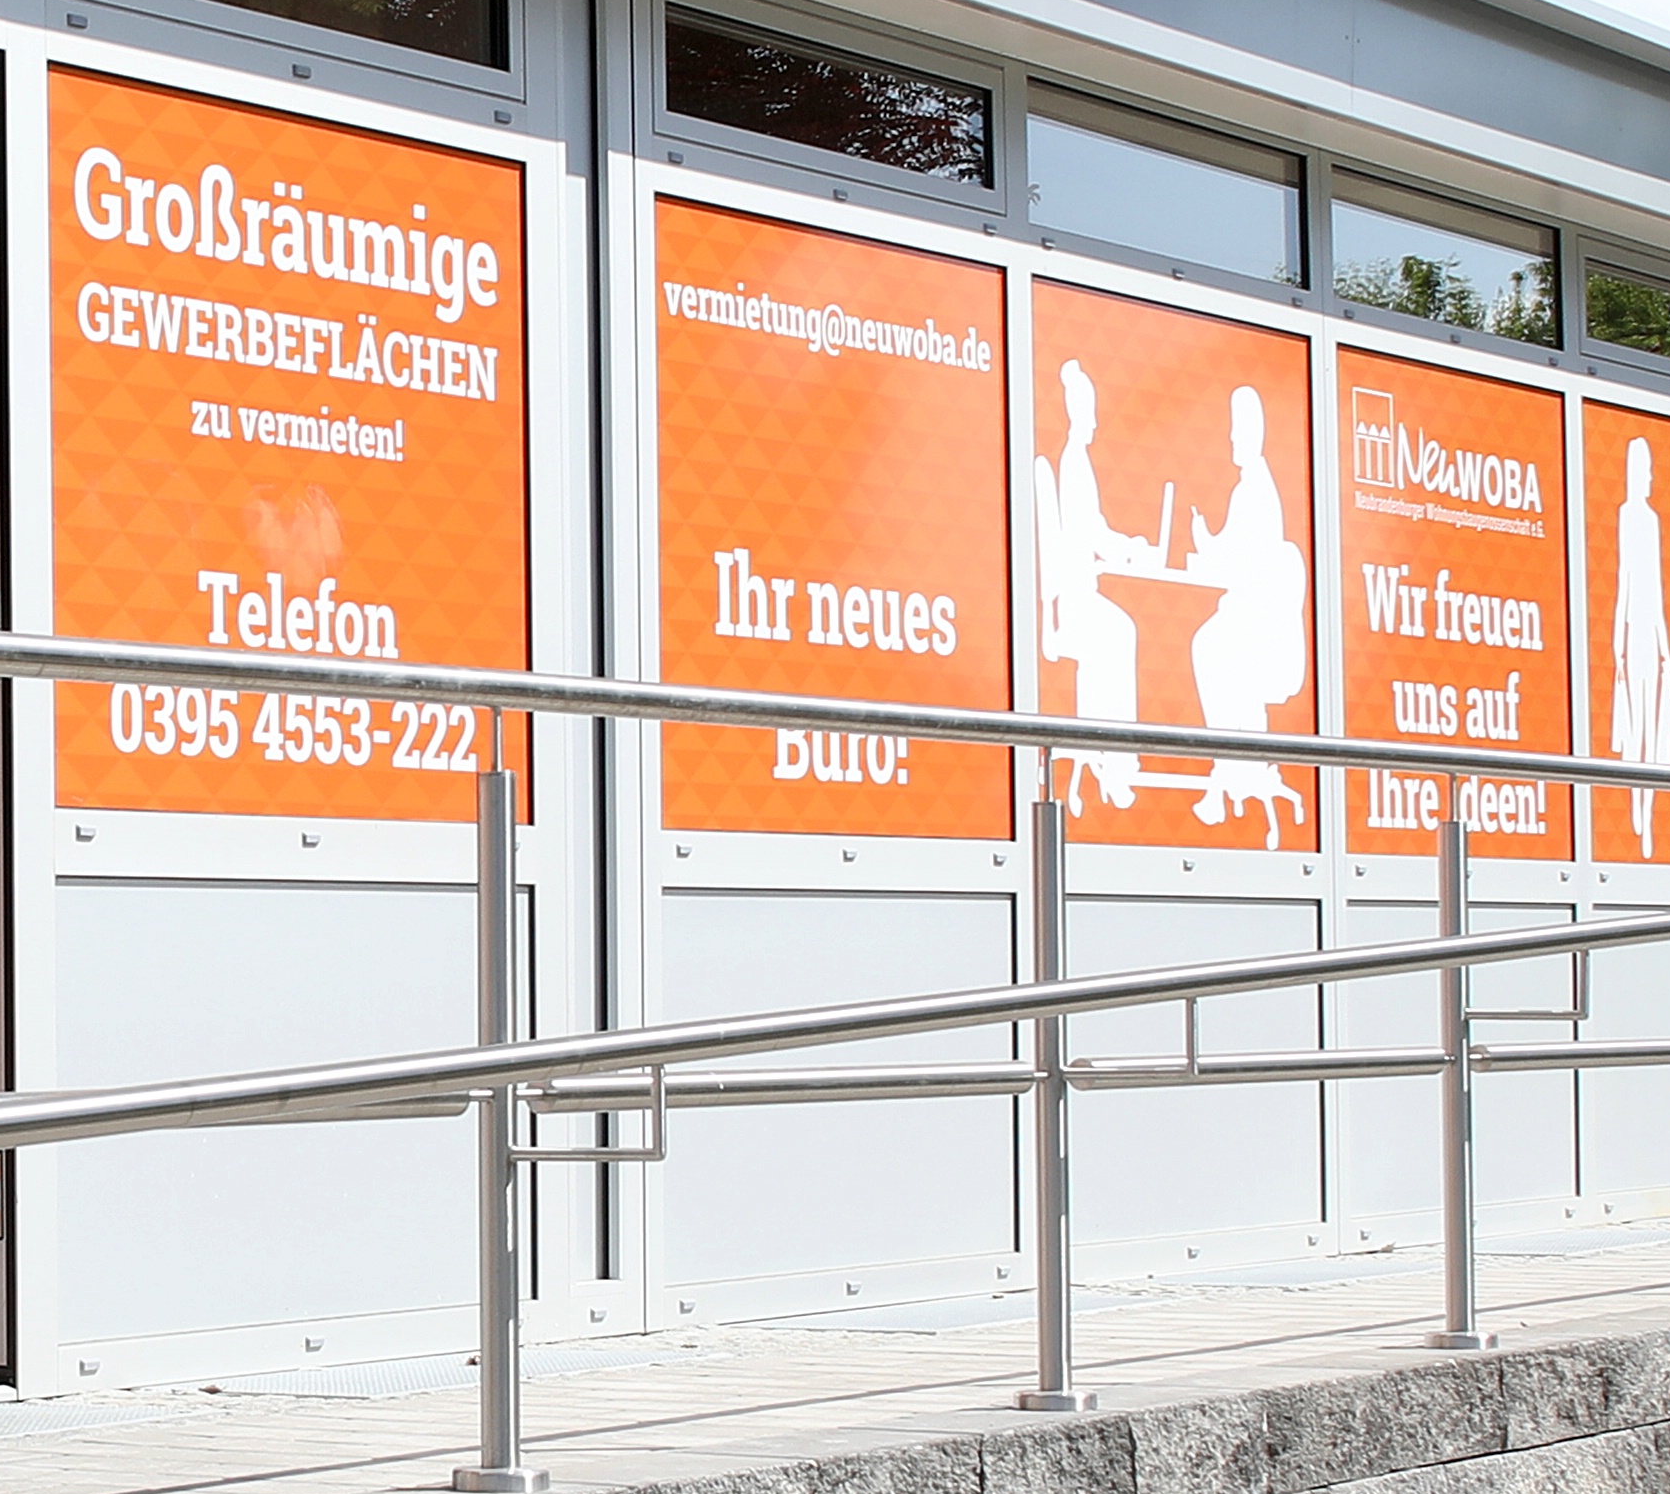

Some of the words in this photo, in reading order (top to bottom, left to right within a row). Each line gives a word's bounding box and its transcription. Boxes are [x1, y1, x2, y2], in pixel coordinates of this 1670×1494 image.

[74, 146, 499, 323] Großräumige
[78, 282, 498, 401] GEWERBEFLÄCHEN
[664, 281, 992, 372] vermietung@neuwoba.de
[191, 401, 231, 438] zu
[239, 406, 404, 461] vermieten!
[1398, 422, 1542, 513] NeuWOBA
[198, 570, 398, 658] Telefon
[714, 548, 794, 641] Ihr
[807, 579, 957, 656] neues
[1362, 563, 1427, 637] Wir
[1435, 569, 1544, 650] freuen
[111, 684, 238, 759] 0395
[252, 693, 477, 772] 4553-222
[1392, 680, 1458, 736] uns
[1465, 671, 1520, 740] auf
[1367, 768, 1439, 830] Ihre
[1460, 775, 1546, 834] deen!
